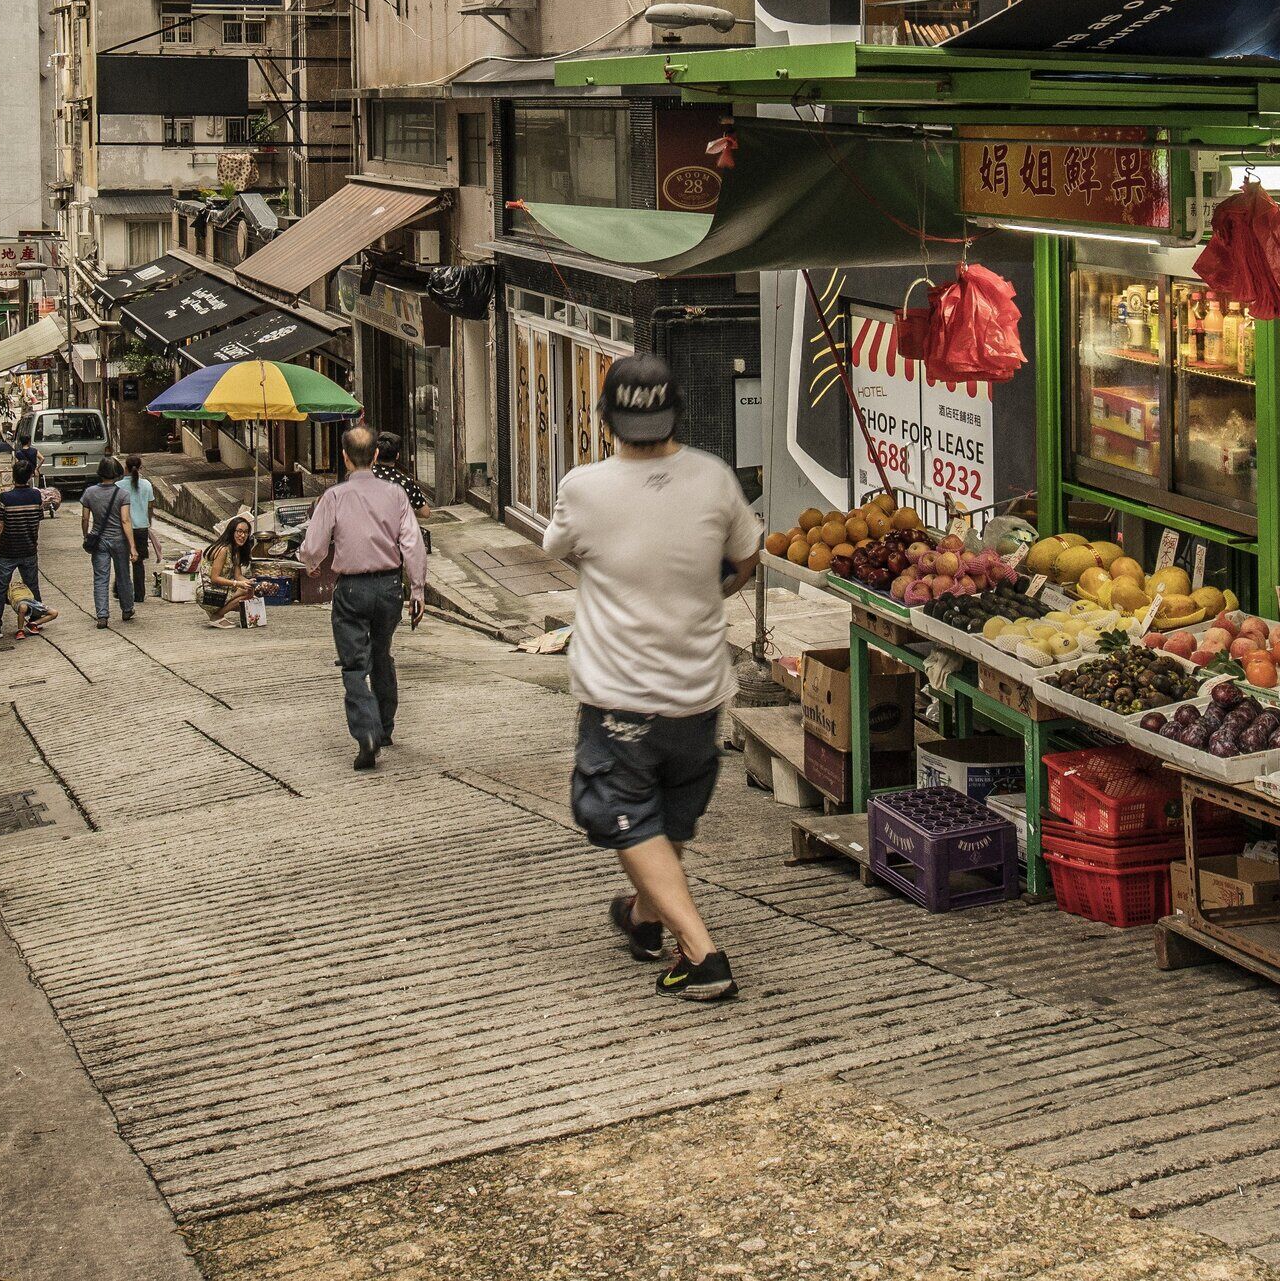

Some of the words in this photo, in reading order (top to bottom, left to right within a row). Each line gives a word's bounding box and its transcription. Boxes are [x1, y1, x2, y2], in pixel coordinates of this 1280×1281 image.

[676, 172, 710, 182] ROOM
[684, 179, 703, 194] 28
[979, 144, 1147, 207] 娟姐鮮果
[858, 386, 888, 397] HOTEL
[860, 406, 897, 436] SHOP
[902, 419, 933, 449] FOR
[937, 430, 985, 465] LEASE
[867, 436, 911, 475] 6688
[932, 457, 983, 501] 8232
[802, 702, 837, 737] unkist
